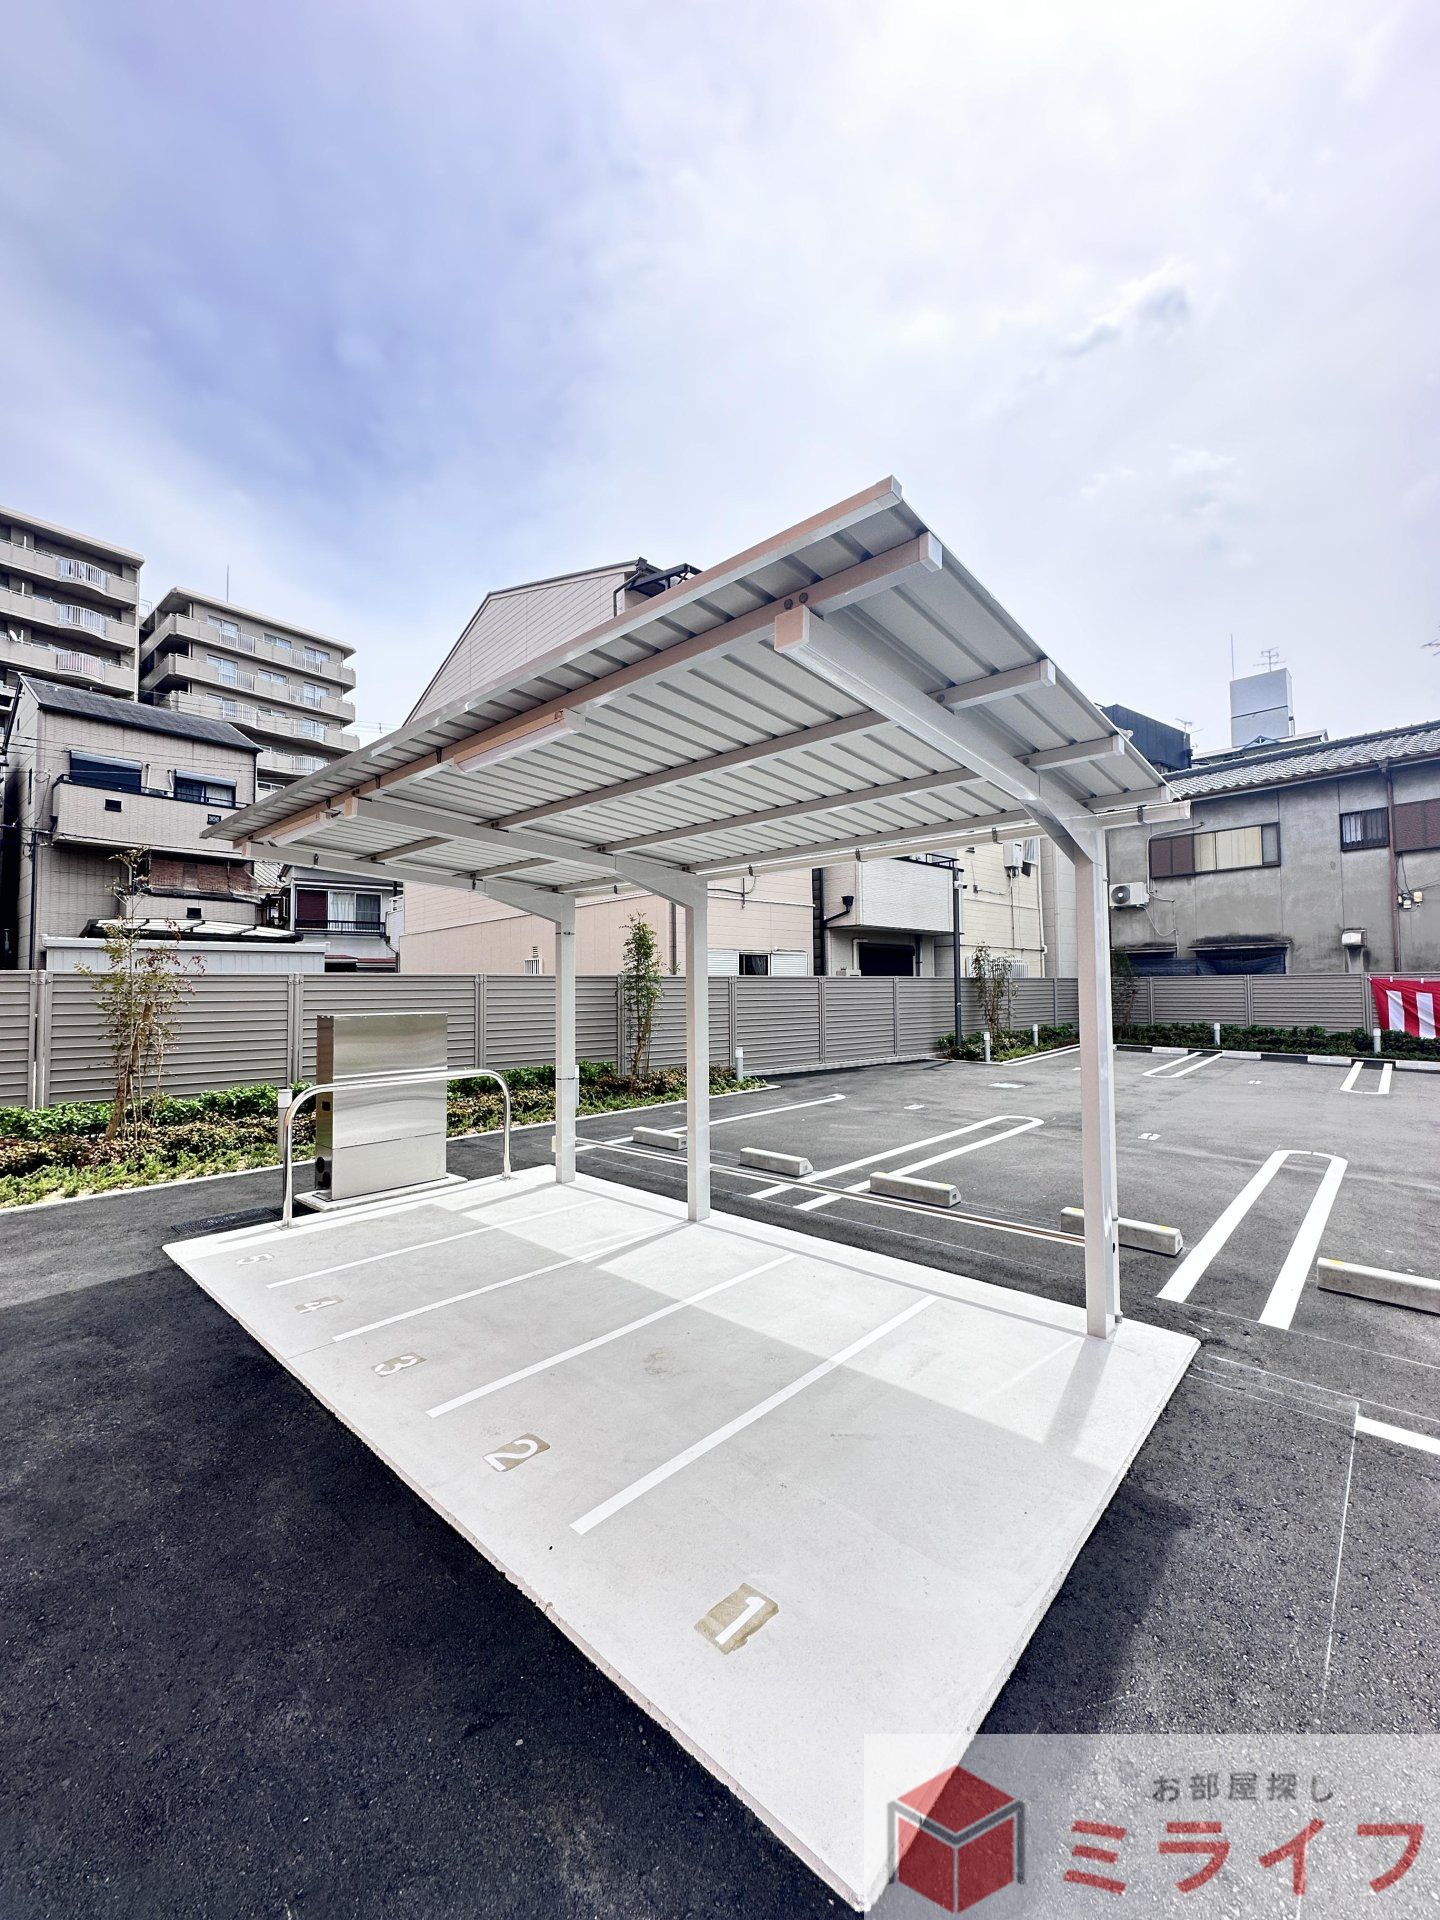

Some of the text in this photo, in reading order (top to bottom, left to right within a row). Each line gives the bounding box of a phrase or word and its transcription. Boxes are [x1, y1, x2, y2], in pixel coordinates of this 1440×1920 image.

[299, 1299, 339, 1314] 4
[374, 1354, 417, 1376] 3
[482, 1439, 538, 1471] 2
[714, 1596, 766, 1645] 1
